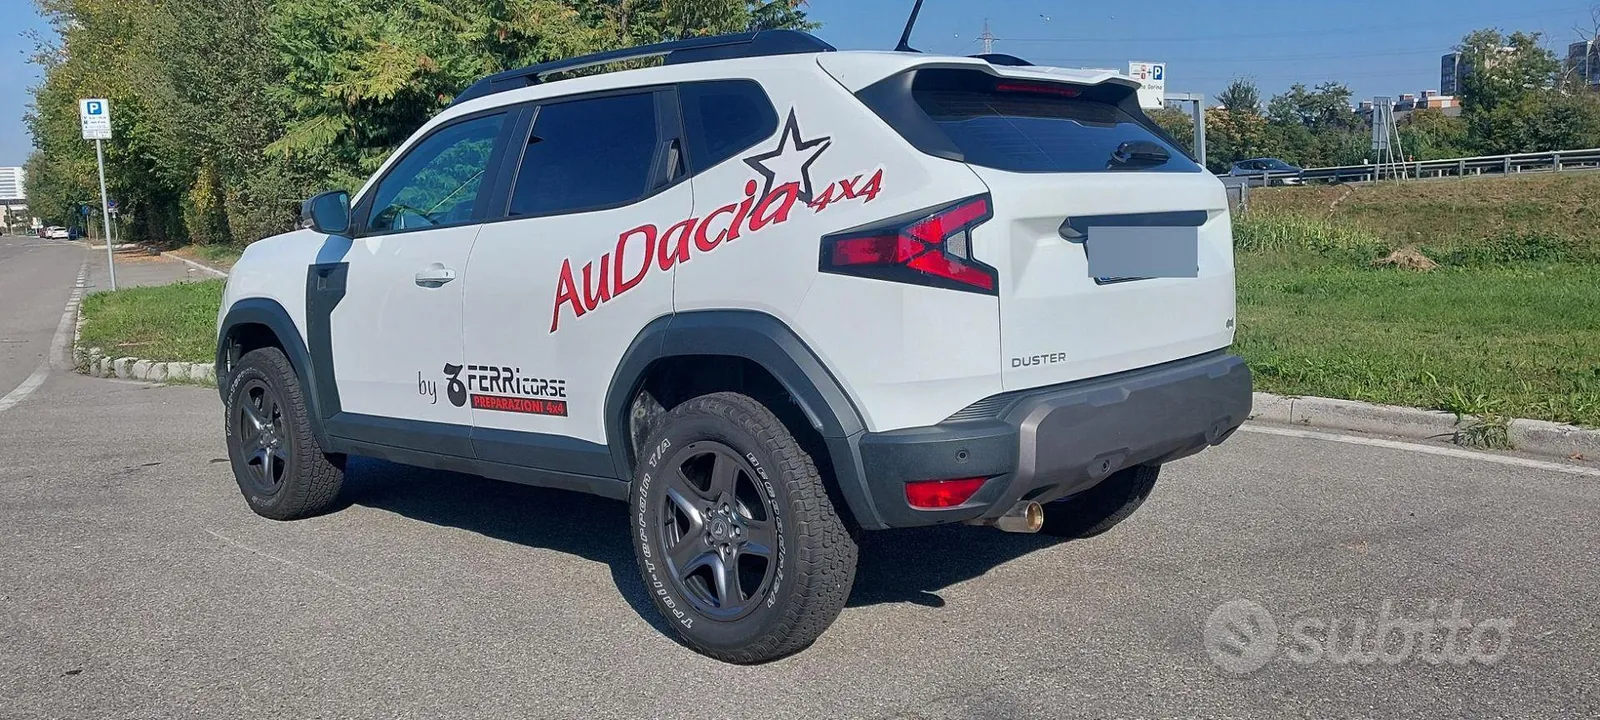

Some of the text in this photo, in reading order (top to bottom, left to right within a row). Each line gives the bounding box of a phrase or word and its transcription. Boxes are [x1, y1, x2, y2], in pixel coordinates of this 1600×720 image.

[1154, 67, 1161, 79] P
[89, 102, 99, 114] P
[550, 179, 799, 333] AuDacia
[1011, 352, 1066, 368] DUSTER
[418, 371, 437, 404] by
[522, 377, 566, 398] CORSE
[473, 395, 544, 413] PREPARAZIONI
